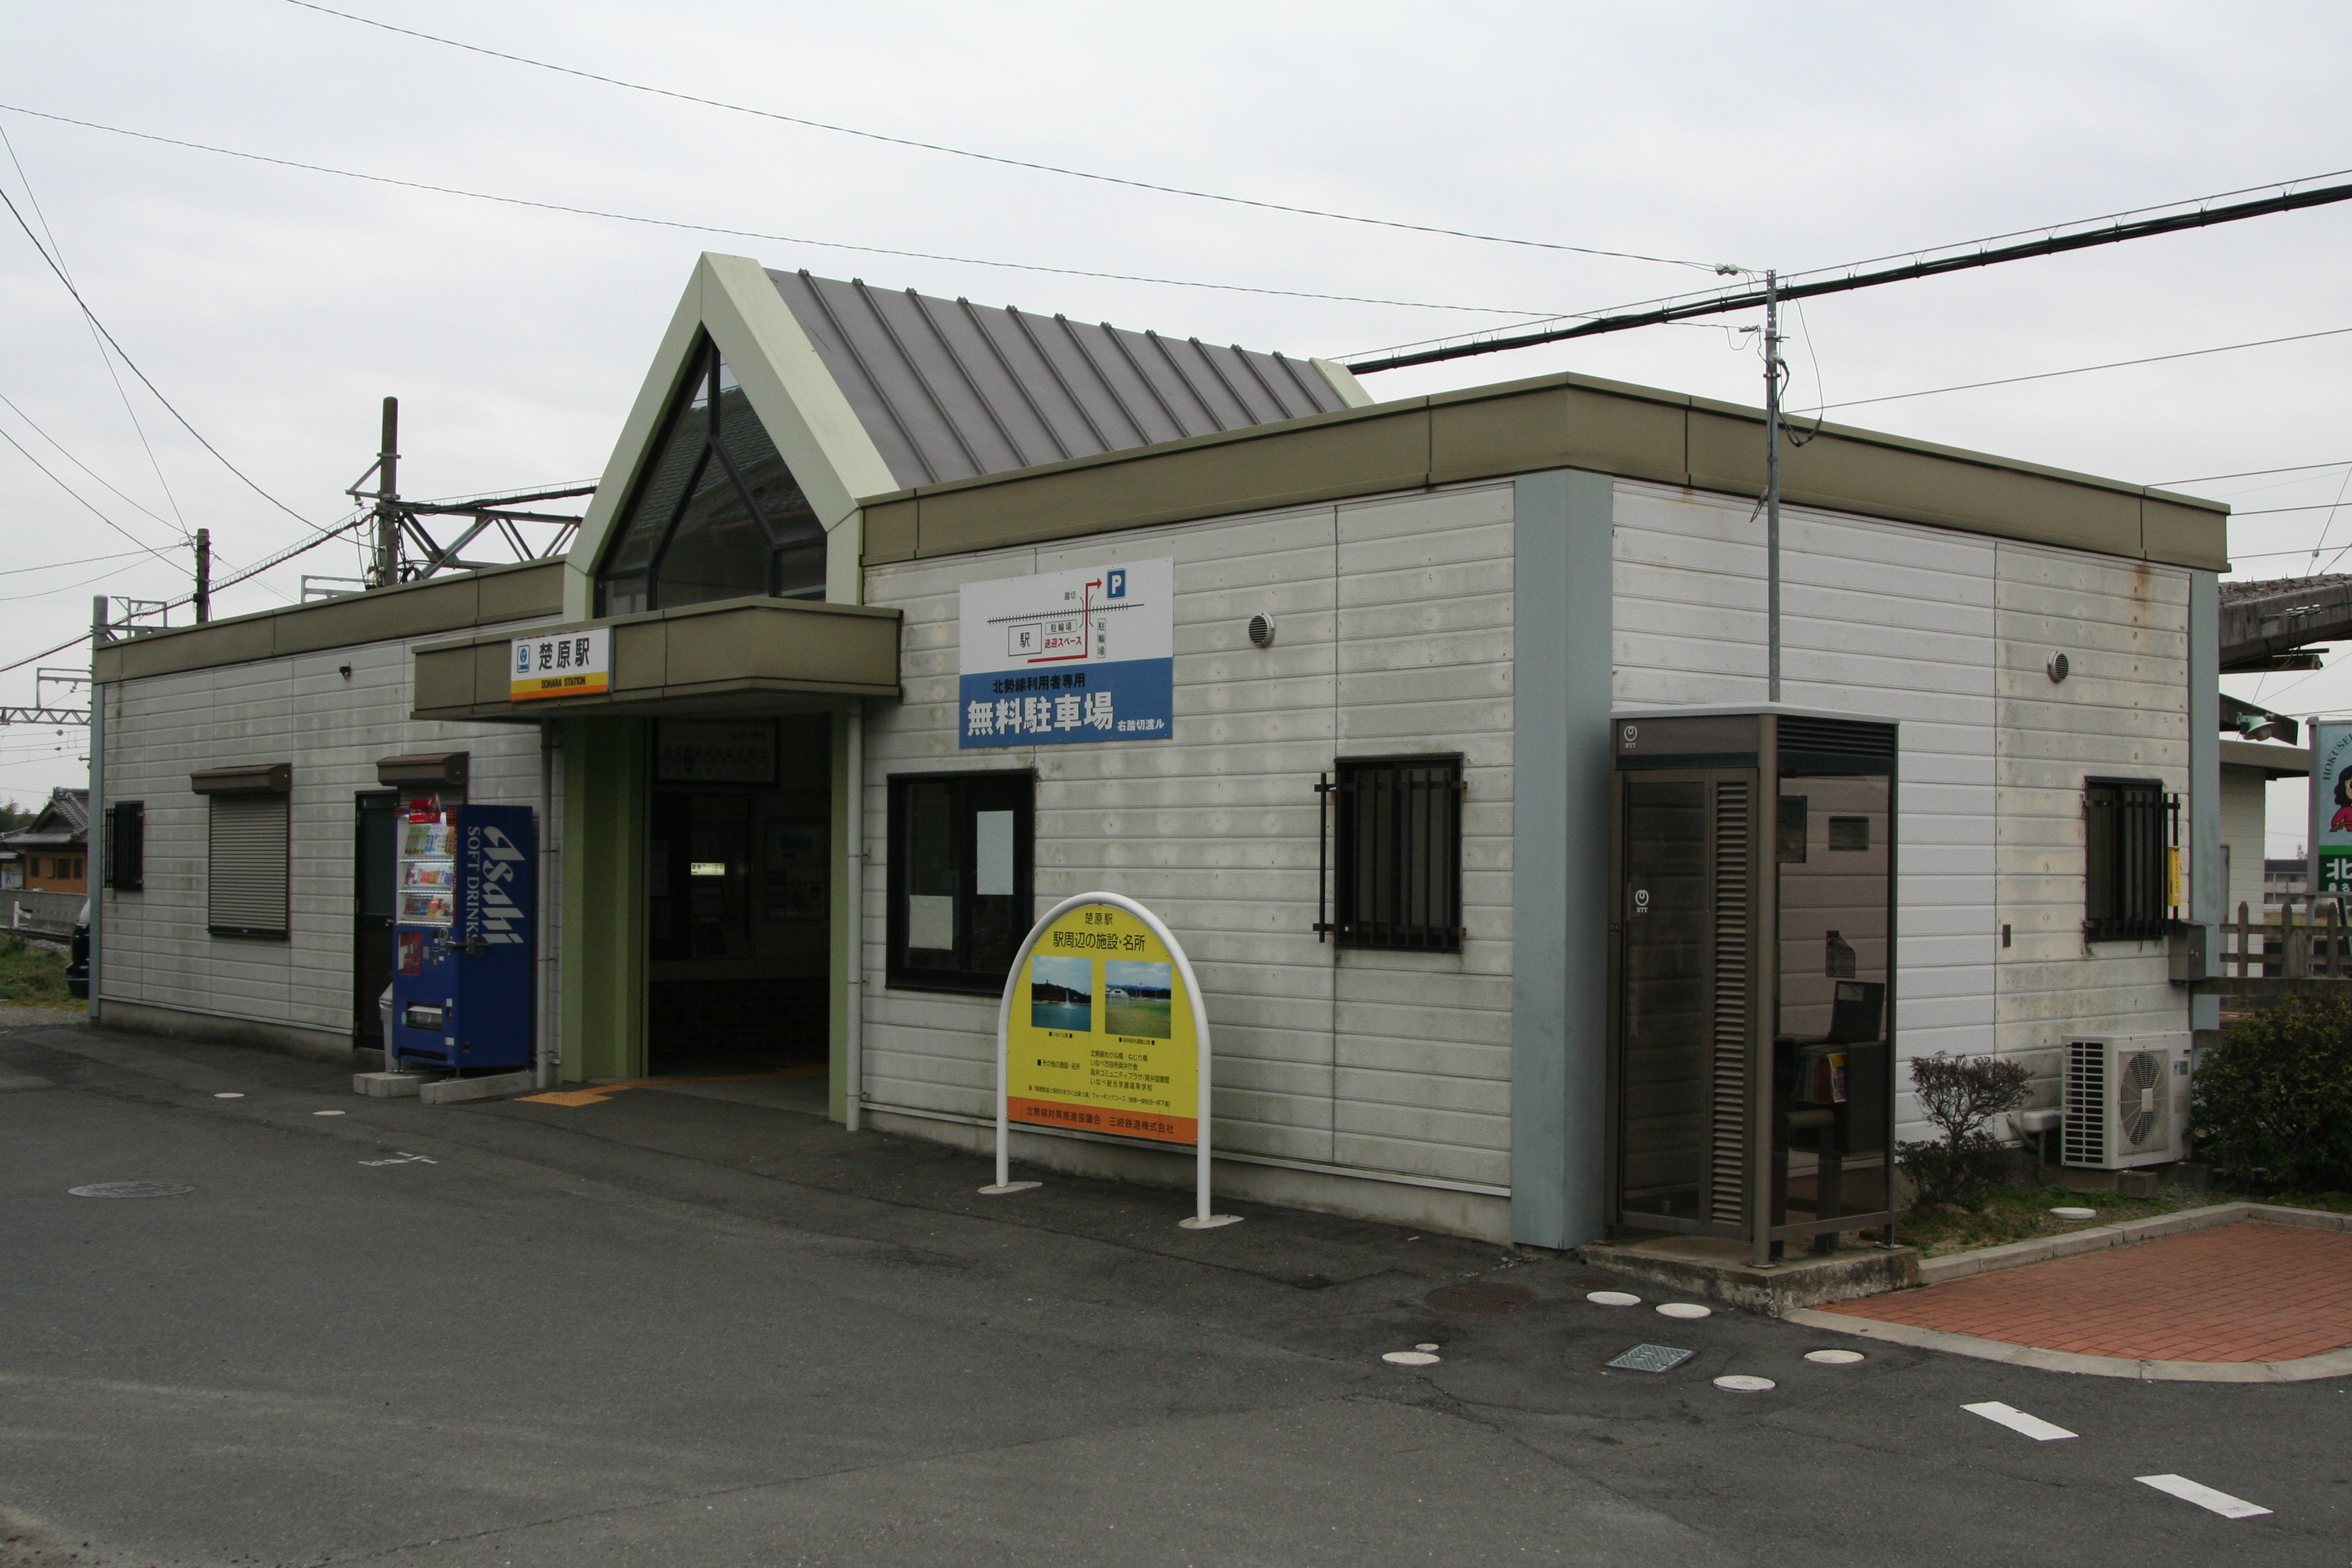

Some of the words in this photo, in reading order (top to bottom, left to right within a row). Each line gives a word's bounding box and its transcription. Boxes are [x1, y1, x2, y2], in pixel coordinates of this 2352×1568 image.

[1111, 574, 1122, 595] P
[1051, 621, 1072, 632] 駐輪場
[1019, 632, 1030, 648] 駅
[1044, 636, 1082, 649] 送迎スペース
[538, 637, 590, 670] 楚原駅
[541, 679, 562, 689] SOHARA
[564, 676, 586, 687] STATION
[992, 672, 1085, 693] 北勢線利用者専用
[966, 691, 1113, 737] 無料駐車場
[1117, 718, 1164, 732] 右踏切渡ル
[467, 826, 480, 871] SOFT
[481, 826, 526, 943] Asahi
[1083, 912, 1113, 926] 楚原駅
[1053, 931, 1145, 951] 駅周辺の施設・名所
[1109, 1117, 1174, 1134] 三岐鉄道株式会社
